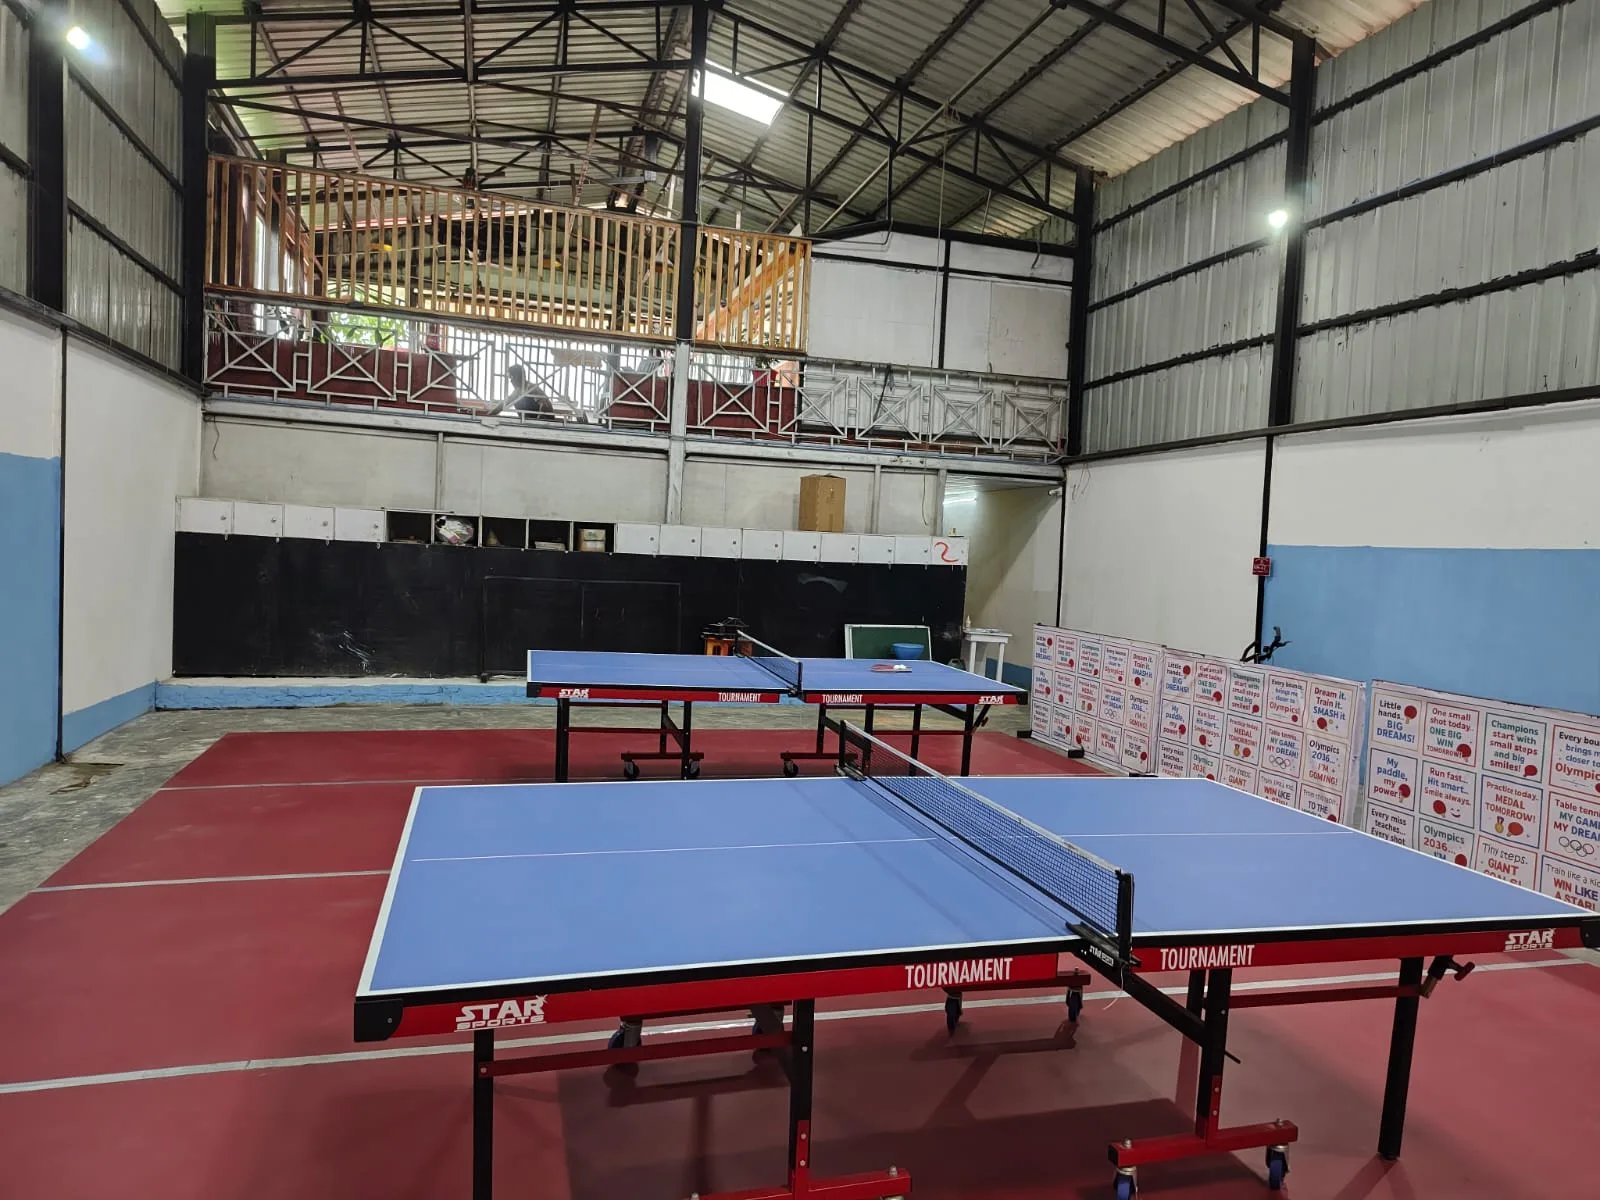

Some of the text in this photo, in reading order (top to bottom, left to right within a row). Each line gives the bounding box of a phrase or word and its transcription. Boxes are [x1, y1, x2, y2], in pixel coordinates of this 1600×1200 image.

[718, 692, 761, 703] TOURNAMENT
[821, 694, 864, 704] TOURNAMENT
[1314, 687, 1337, 699] Dream
[1316, 697, 1334, 707] Train
[1379, 700, 1402, 711] Little
[1313, 706, 1339, 719] SMASH
[1432, 707, 1471, 722] One small
[1386, 720, 1403, 731] BIG
[1430, 716, 1447, 726] shot
[1491, 719, 1539, 736] Champions
[1376, 728, 1415, 744] DREAMS!
[1429, 726, 1462, 740] ONE BIG
[1492, 730, 1537, 745] start with
[1559, 731, 1600, 747] Every bou
[1309, 740, 1340, 755] Olympics
[1437, 737, 1454, 748] WIN
[1489, 740, 1538, 756] small steps
[1565, 743, 1592, 757] brings
[1386, 757, 1399, 769] My
[1494, 749, 1525, 765] and big
[1565, 755, 1590, 765] closer
[1430, 767, 1445, 778] Run
[1490, 759, 1521, 773] smiles!
[1555, 762, 1600, 781] Olympic
[1228, 774, 1247, 787] GIANT
[1376, 766, 1408, 782] paddle,
[1427, 776, 1440, 787] Hit
[1383, 778, 1396, 788] my
[1486, 780, 1514, 795] Practice
[1264, 786, 1277, 796] WIN
[1424, 787, 1472, 806] Smile always.
[1308, 801, 1316, 810] TO
[1317, 803, 1329, 814] THE
[1495, 794, 1526, 810] MEDAL
[1555, 799, 1600, 818] Table tenni
[1371, 808, 1407, 826] Every miss
[1485, 802, 1536, 823] TOMORROW!
[1559, 811, 1574, 822] MY
[1553, 821, 1569, 832] MY
[1370, 827, 1405, 845] Every shot
[1423, 824, 1465, 845] Olympics
[1482, 842, 1529, 865] Tiny steps.
[1487, 858, 1519, 876] GIANT
[1545, 863, 1566, 877] Train
[1567, 870, 1581, 881] like
[1582, 876, 1588, 884] a
[1553, 877, 1599, 902] WIN LIKE
[1555, 891, 1596, 911] A STAR!
[1505, 928, 1556, 945] STAR
[1160, 944, 1255, 970] TOURNAMENT
[905, 957, 1013, 989] TOURNAMENT
[455, 994, 548, 1022] STAR
[456, 1014, 545, 1030] SPORTS
